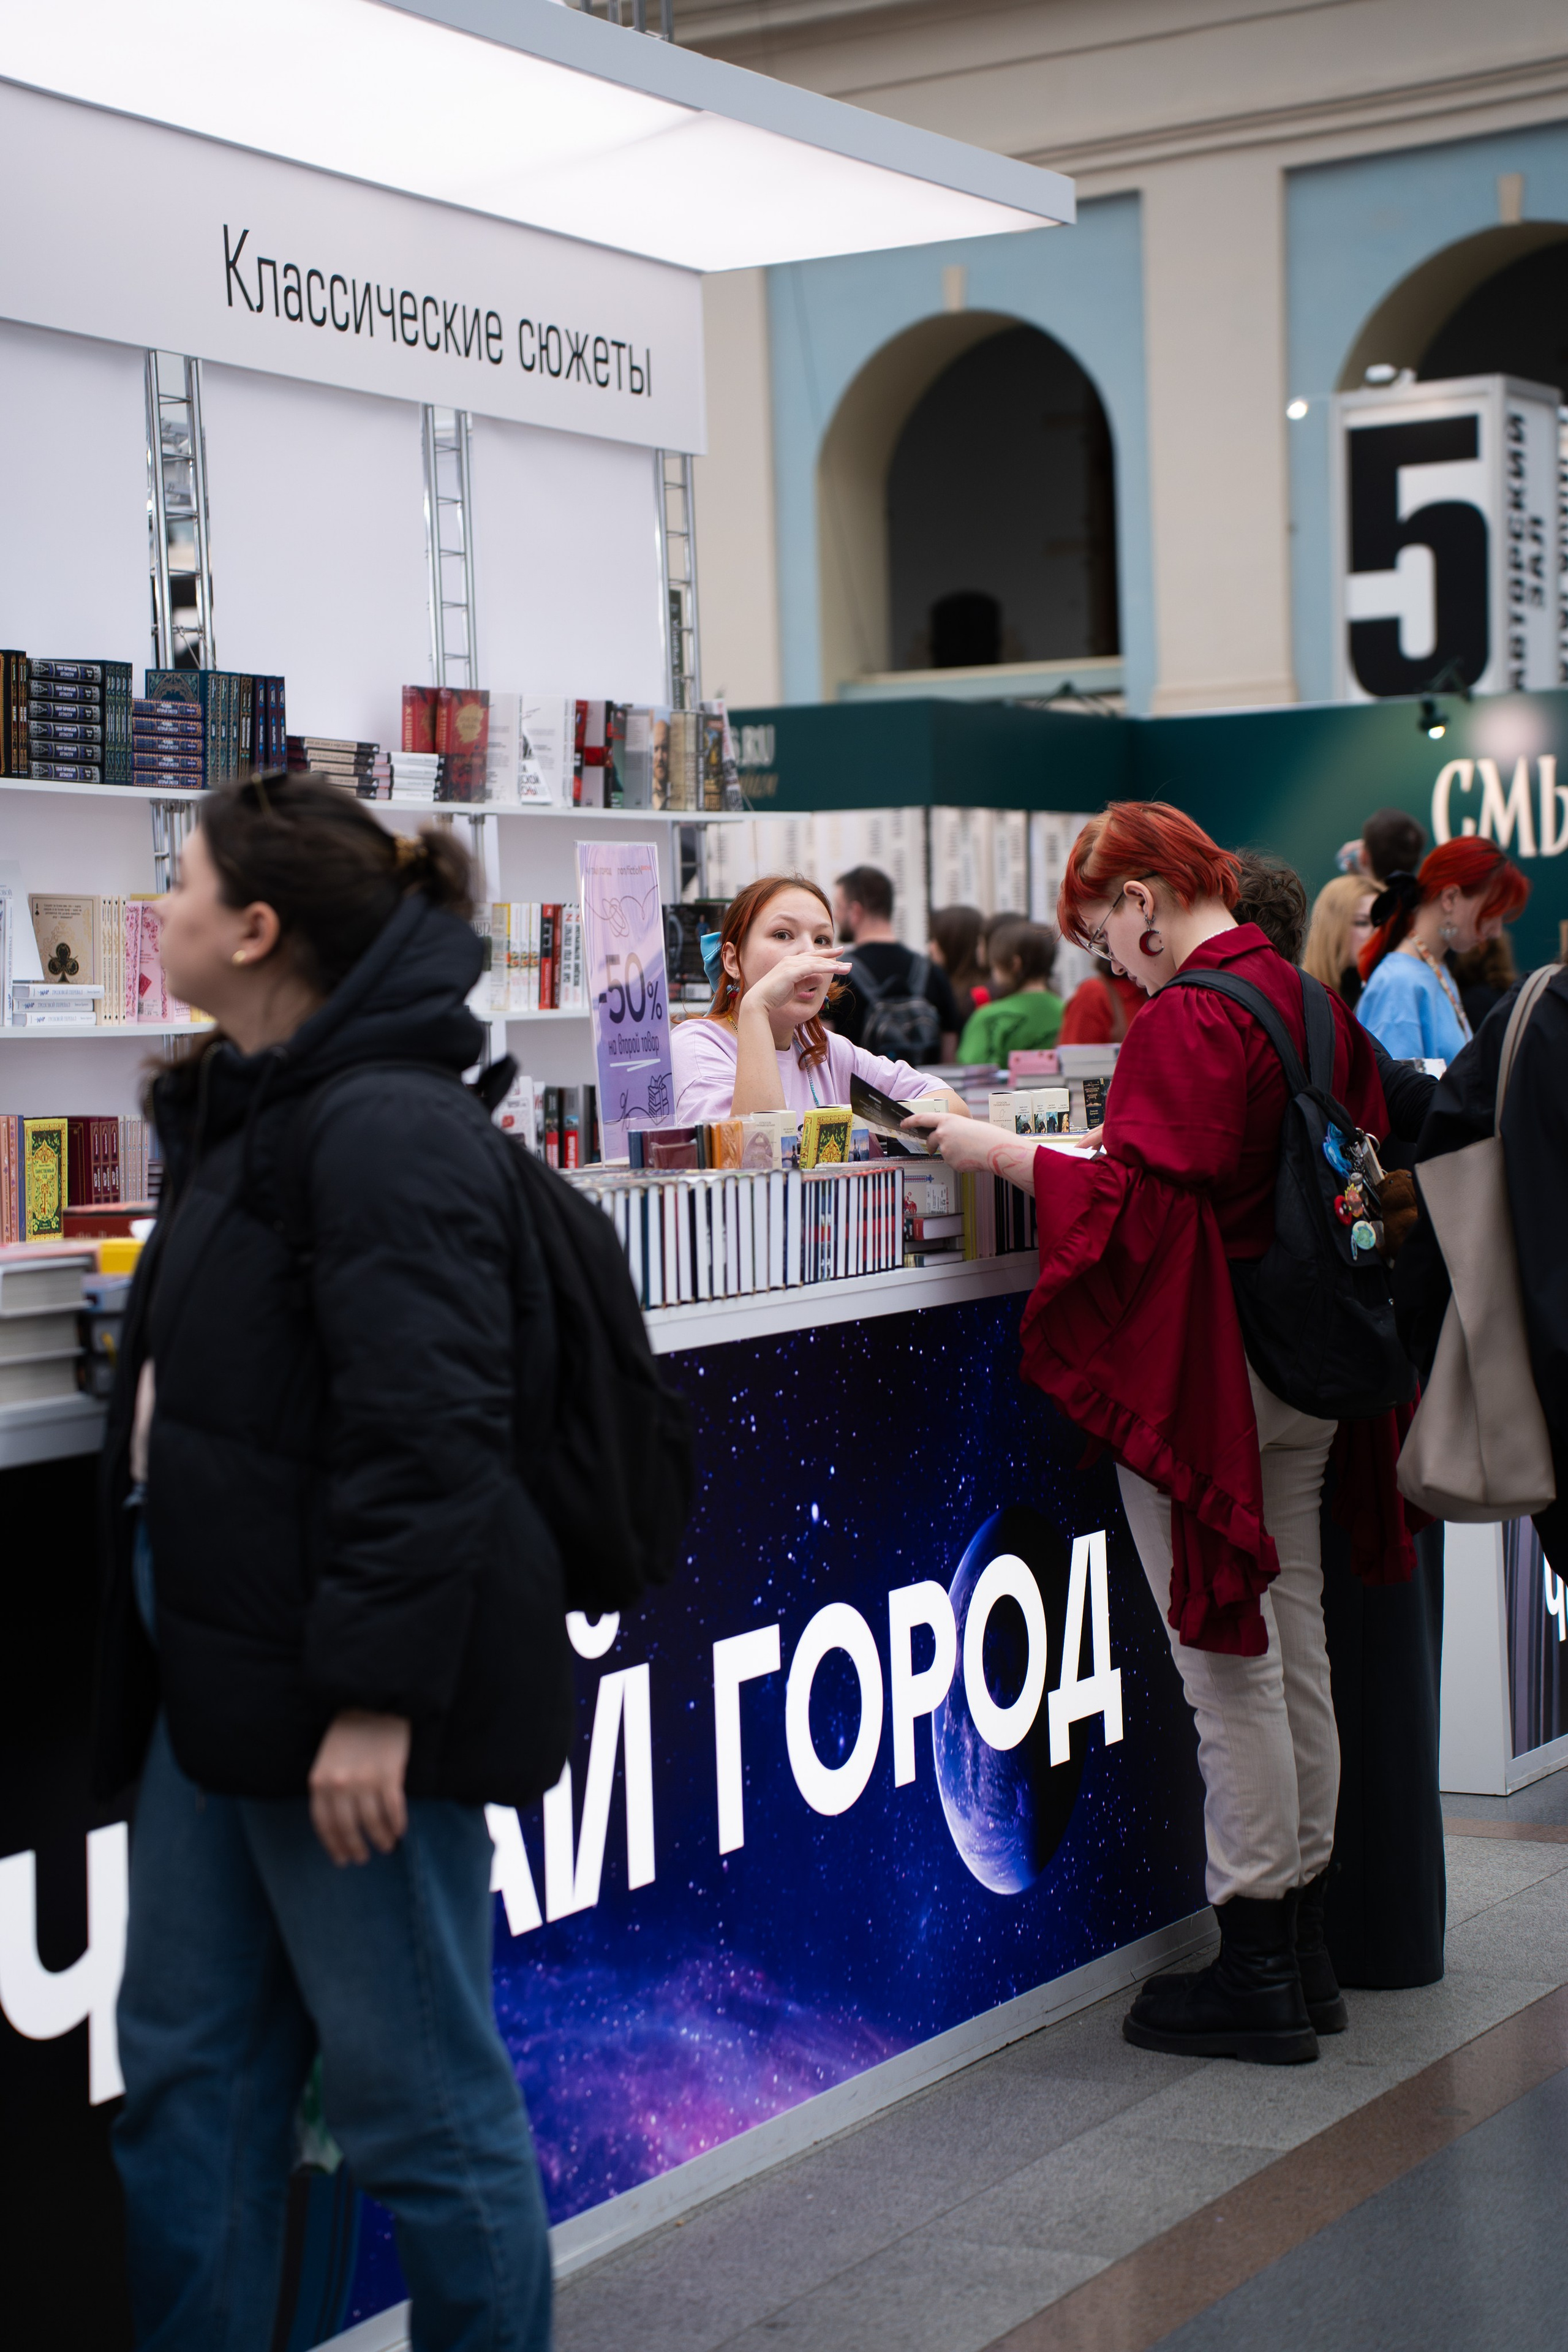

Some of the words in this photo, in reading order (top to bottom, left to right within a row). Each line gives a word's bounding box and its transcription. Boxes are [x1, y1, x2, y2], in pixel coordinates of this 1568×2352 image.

[223, 224, 503, 365] Классические
[519, 318, 652, 398] сюжеты
[1348, 414, 1489, 698] 5
[608, 1039, 617, 1055] на
[617, 1031, 641, 1060] второй
[642, 1031, 660, 1056] товар
[713, 1529, 1123, 1855] ГОРОД
